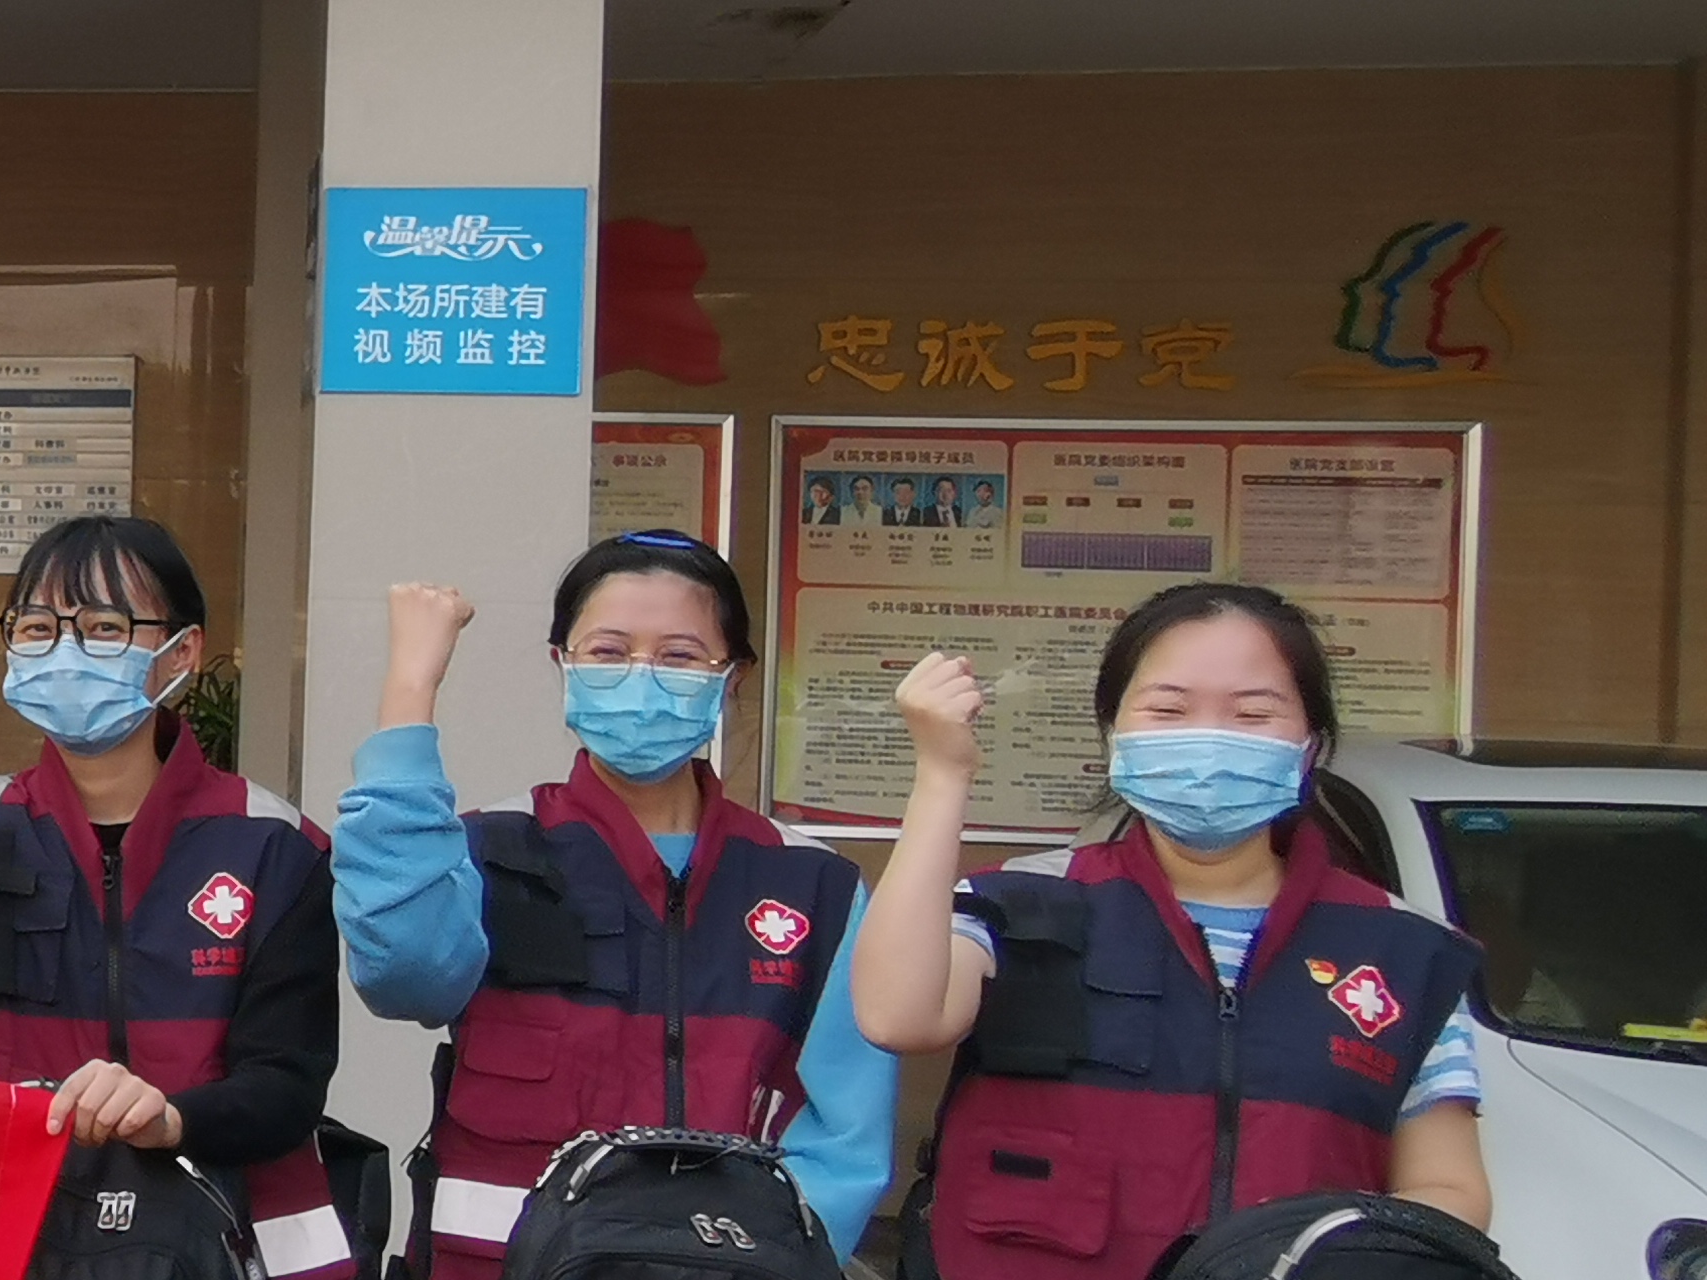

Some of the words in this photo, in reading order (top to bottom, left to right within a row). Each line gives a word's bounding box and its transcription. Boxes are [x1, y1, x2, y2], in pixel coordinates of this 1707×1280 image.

[363, 214, 543, 261] 温馨提示
[356, 281, 547, 319] 本场所建有
[354, 328, 546, 365] 视频监控
[807, 315, 1235, 392] 忠诚于党
